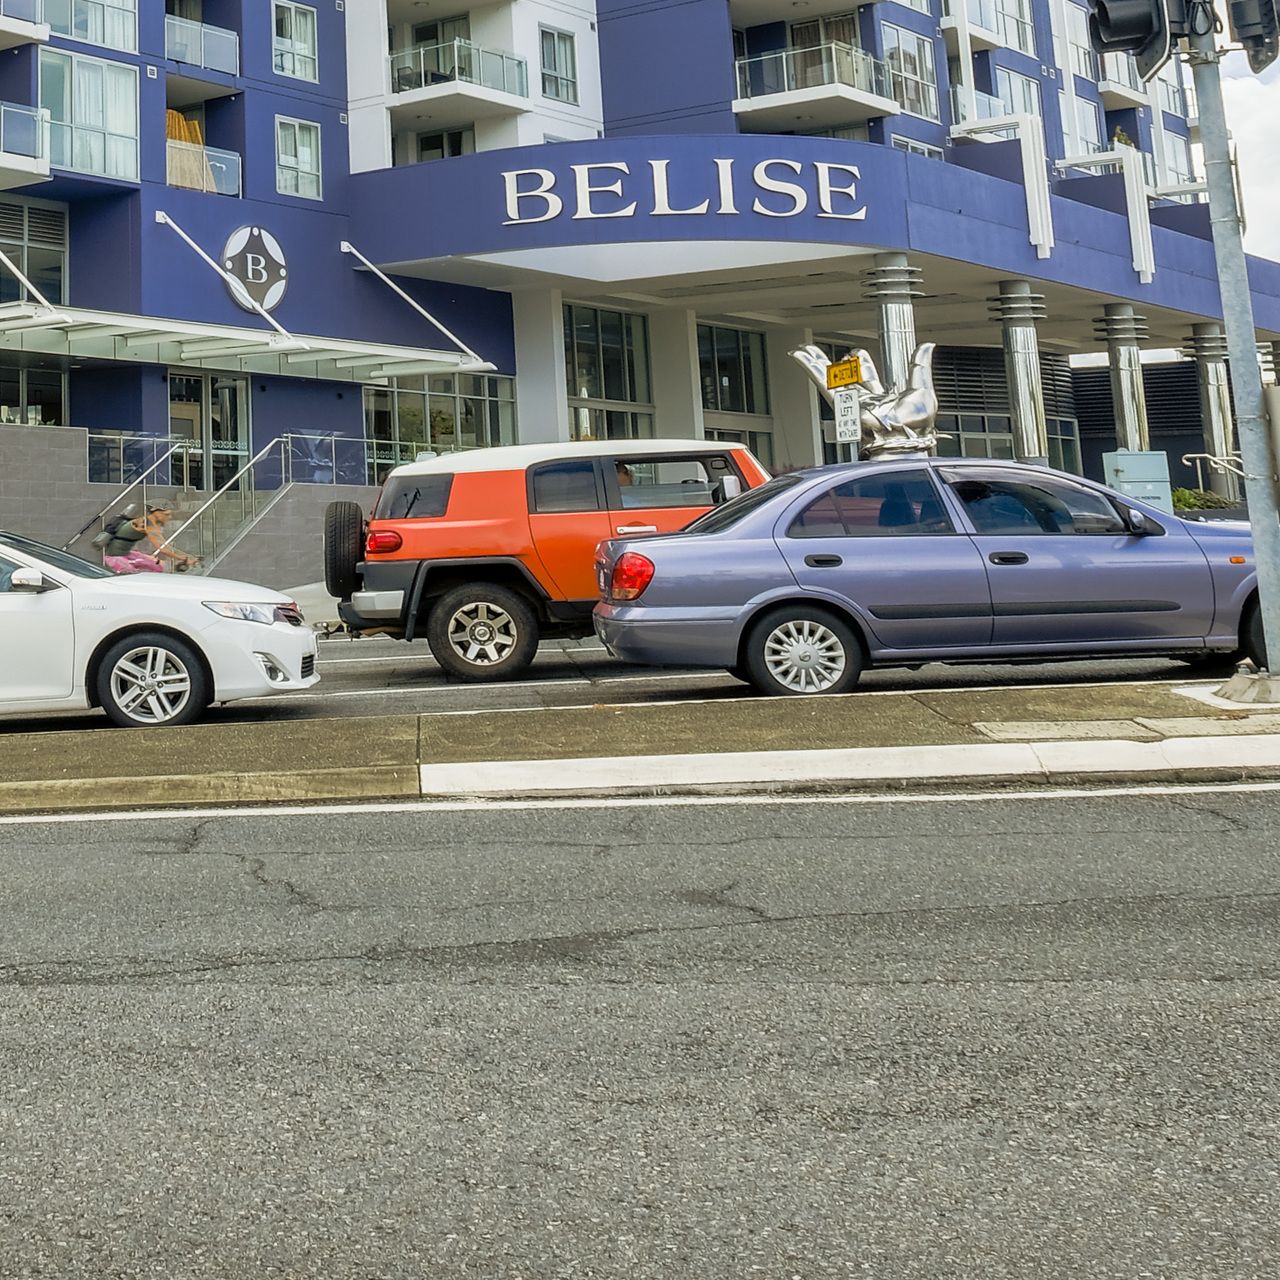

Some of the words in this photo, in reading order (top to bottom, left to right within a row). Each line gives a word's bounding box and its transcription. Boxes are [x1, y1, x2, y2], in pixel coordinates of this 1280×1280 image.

[501, 158, 867, 225] BELISE
[245, 252, 268, 284] B
[840, 406, 853, 417] LEFT
